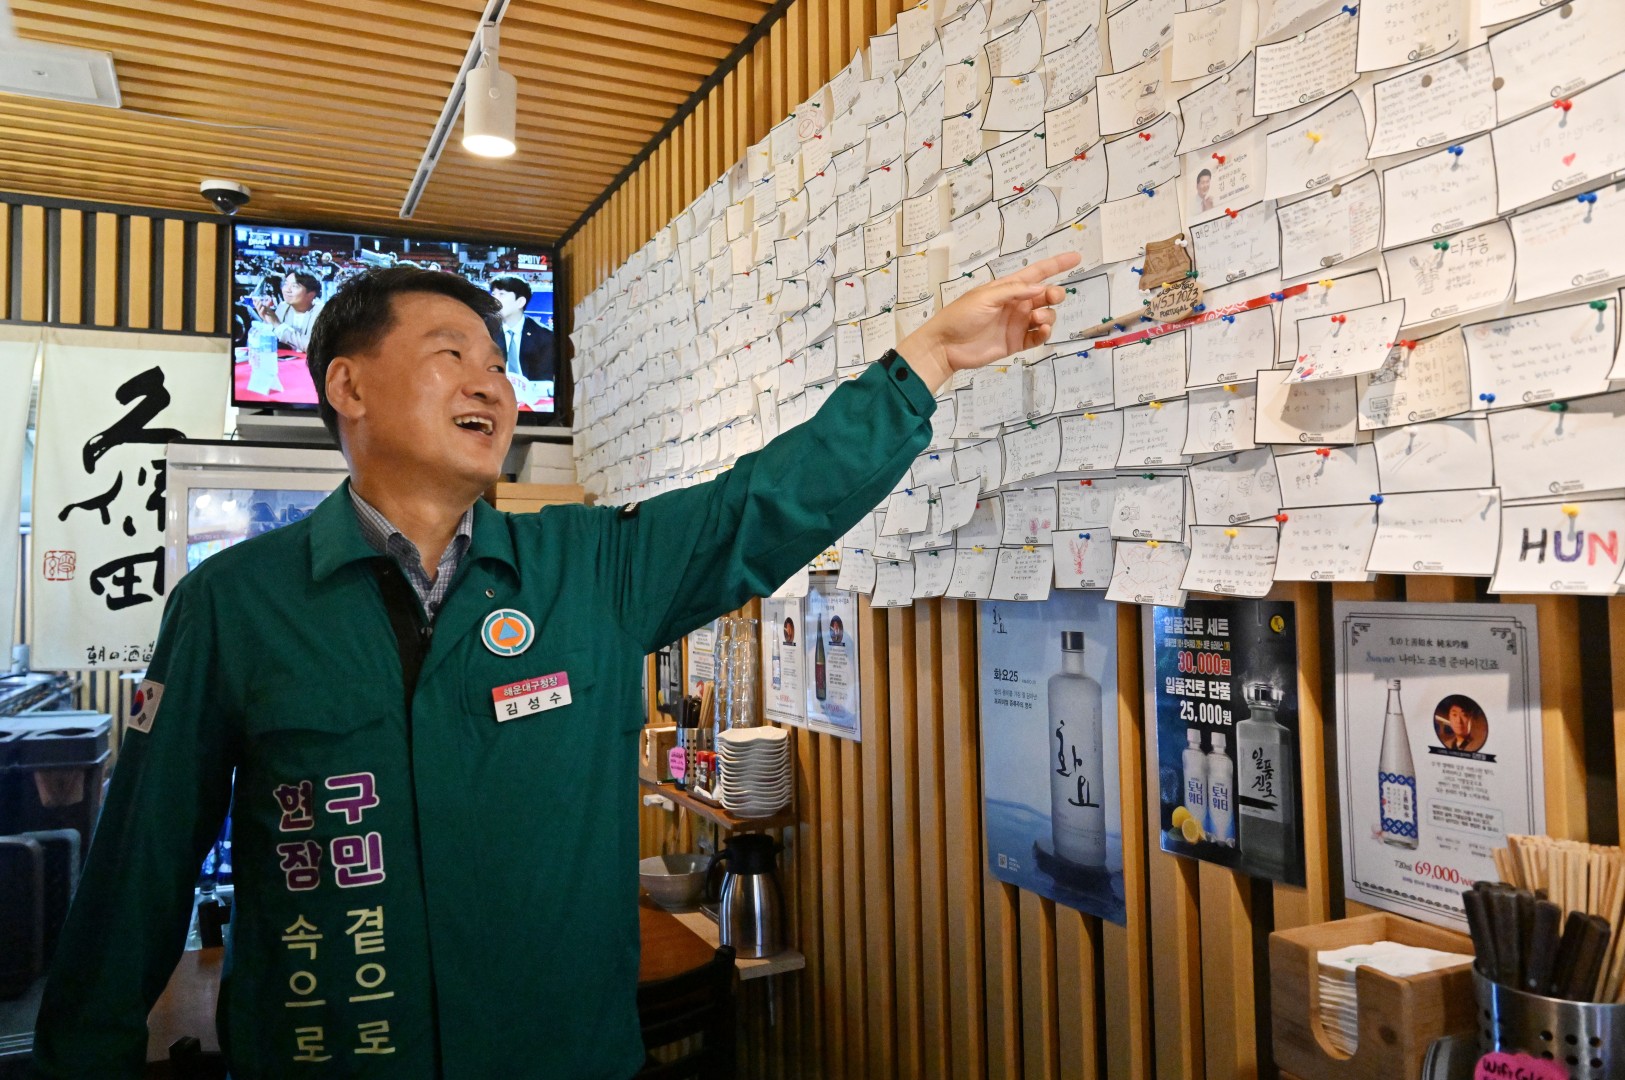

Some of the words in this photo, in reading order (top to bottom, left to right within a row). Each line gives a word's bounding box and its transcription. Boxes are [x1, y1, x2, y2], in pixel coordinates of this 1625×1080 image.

[1176, 287, 1199, 305] 2023
[1160, 304, 1189, 318] PORTUGAL
[1519, 527, 1618, 567] HUN
[1164, 616, 1204, 635] 일품진로
[1207, 617, 1229, 637] 세트
[993, 667, 1019, 683] 화요25
[1178, 650, 1232, 676] 30,000원
[503, 676, 558, 697] 해운대구청장
[1165, 676, 1206, 698] 일품진로
[1208, 681, 1231, 701] 단품
[1180, 700, 1232, 726] 25,000원
[273, 780, 322, 891] 현장
[325, 771, 386, 888] 구민
[1415, 861, 1459, 884] 69,000
[281, 914, 332, 1062] 속으로
[345, 905, 396, 1055] 곁으로
